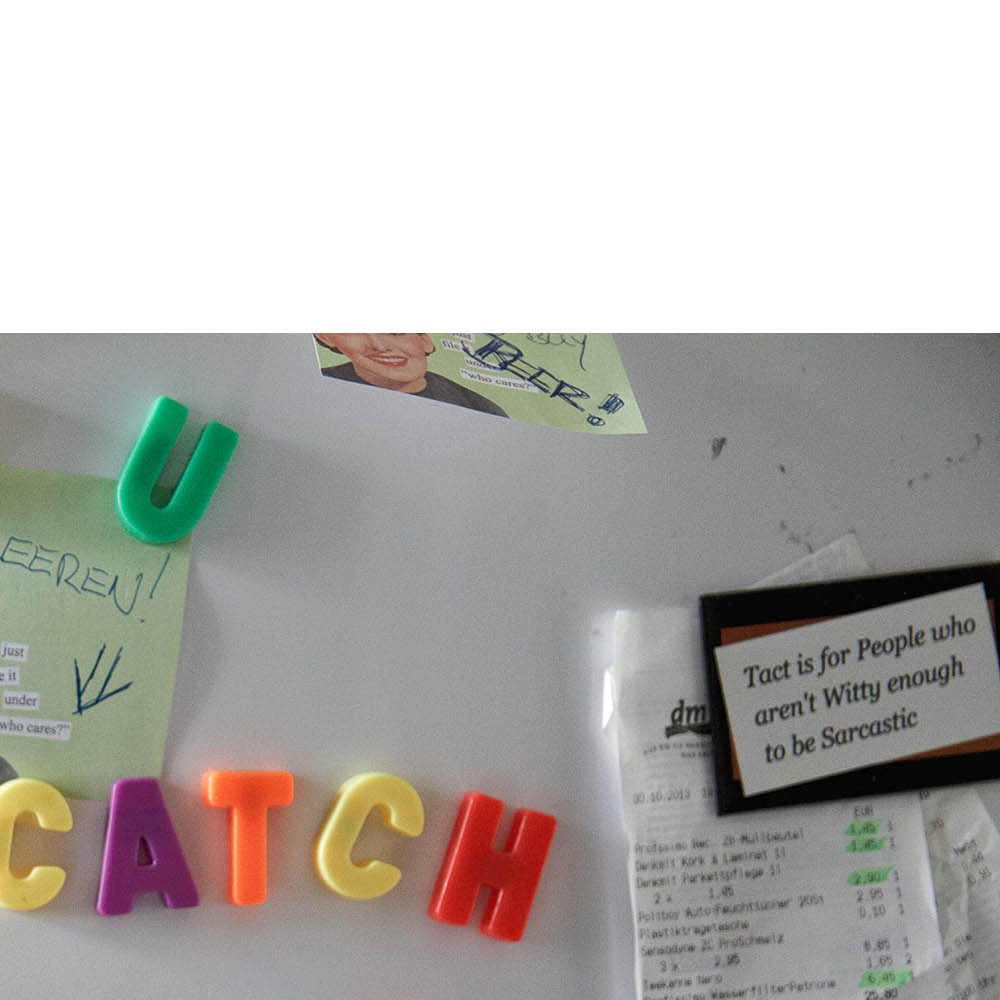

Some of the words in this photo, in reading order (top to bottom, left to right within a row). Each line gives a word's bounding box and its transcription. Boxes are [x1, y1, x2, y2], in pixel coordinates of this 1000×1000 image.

[116, 395, 240, 546] U
[1, 646, 24, 658] just
[8, 669, 17, 681] it
[743, 661, 790, 689] Tact
[797, 653, 815, 674] is
[817, 645, 851, 677] for
[857, 626, 926, 662] People
[931, 615, 976, 643] who
[4, 694, 38, 706] under
[755, 693, 817, 727] aren't
[823, 679, 881, 709] Witty
[887, 655, 964, 694] enough
[765, 743, 785, 764] to
[791, 734, 817, 757] be
[821, 707, 919, 750] Sarcastic
